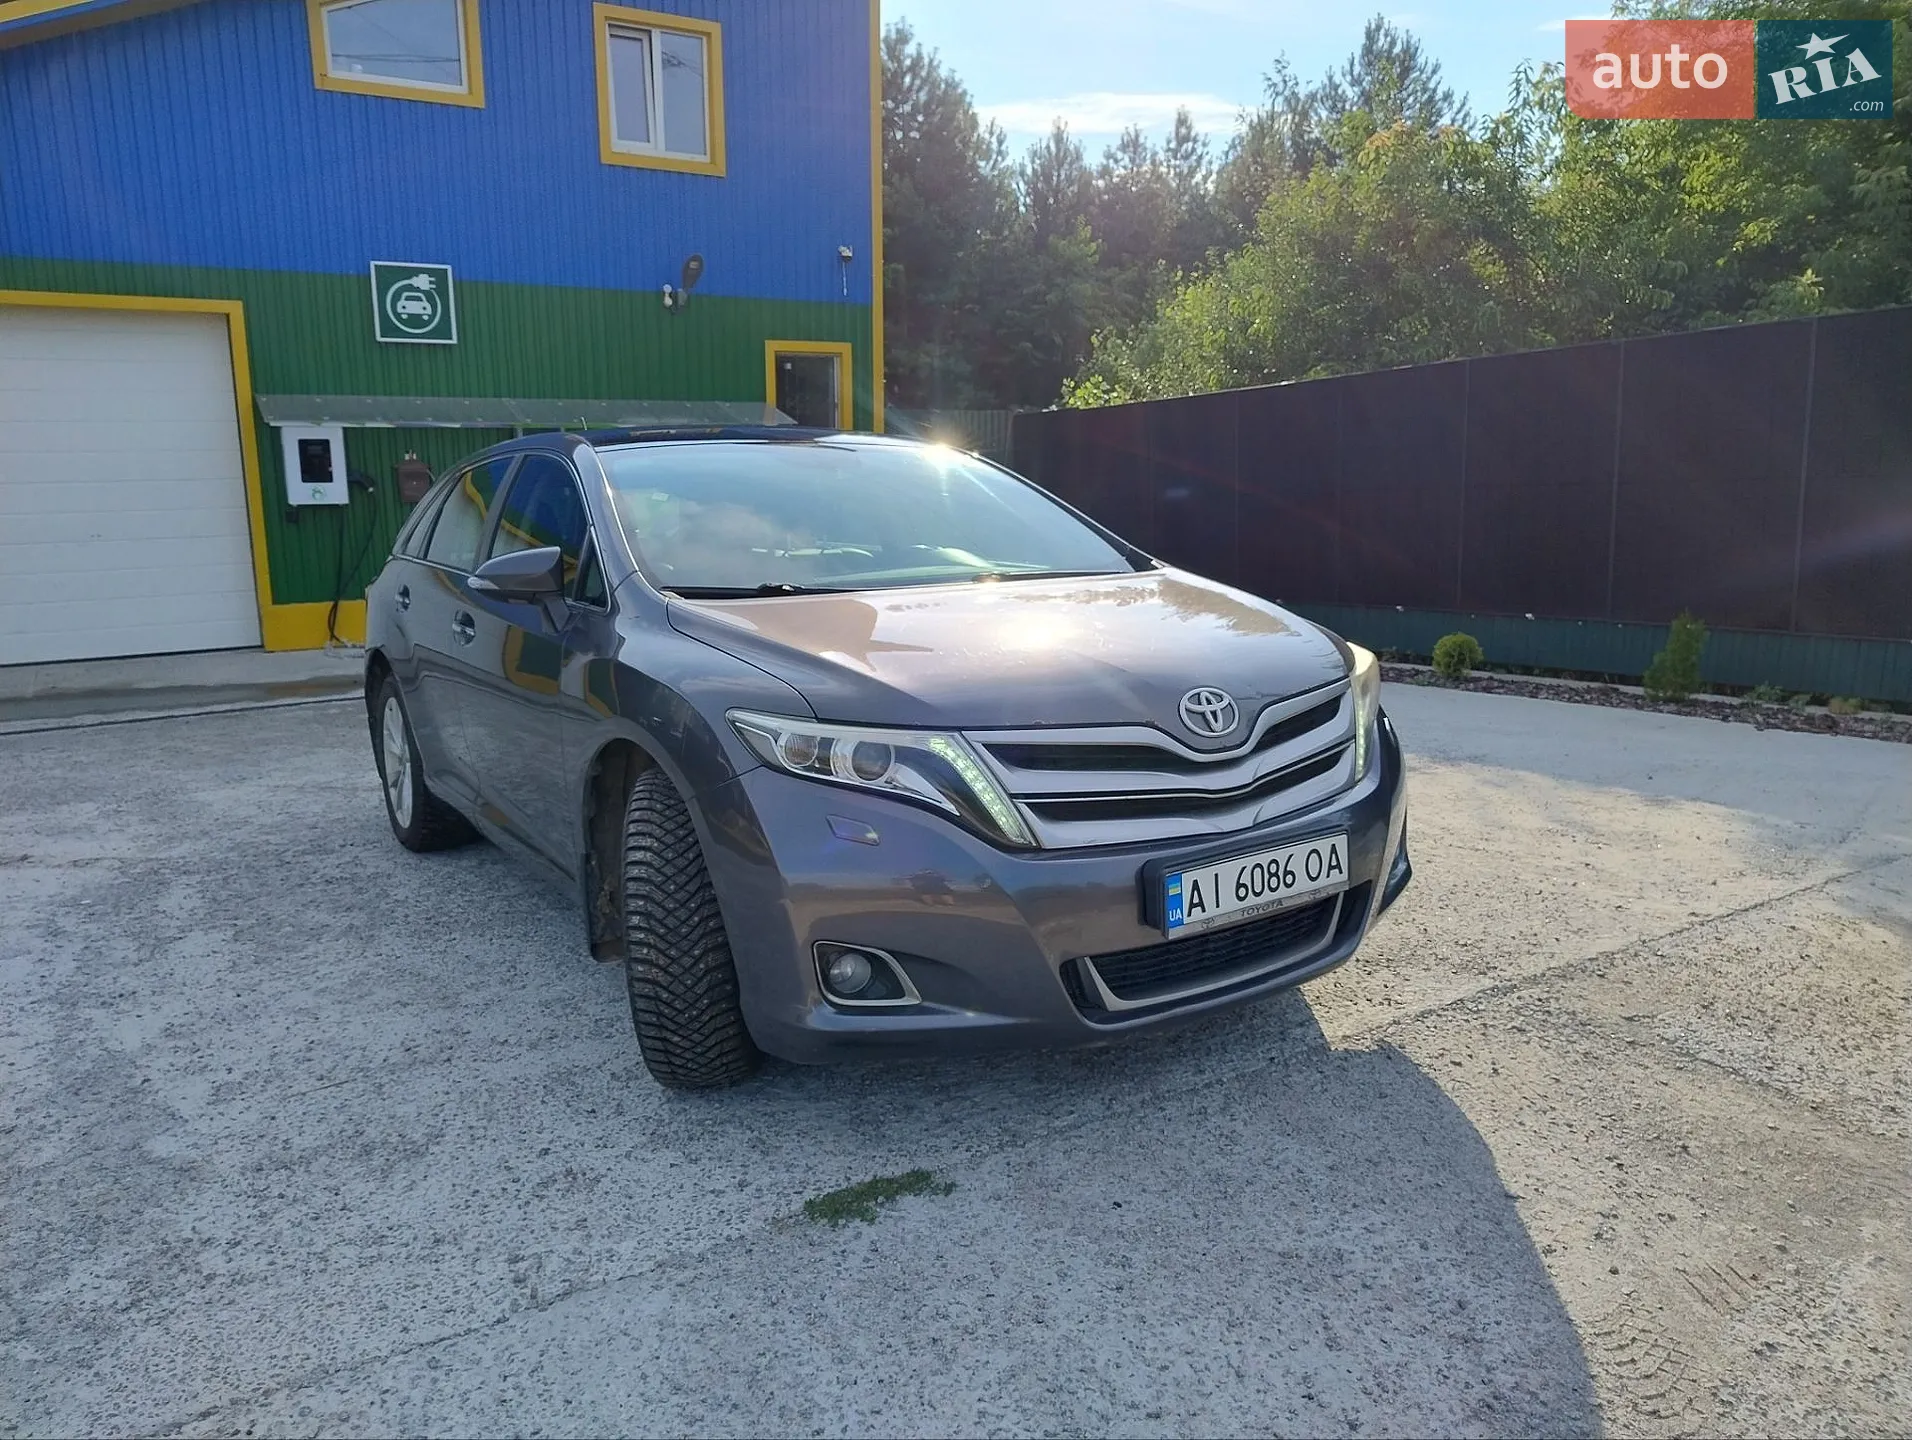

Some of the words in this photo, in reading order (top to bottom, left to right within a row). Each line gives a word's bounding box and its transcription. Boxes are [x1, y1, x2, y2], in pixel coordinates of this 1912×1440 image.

[1187, 872, 1220, 918] AI
[1235, 853, 1297, 902] 6086
[1304, 843, 1344, 883] OA
[1168, 908, 1183, 922] UA
[1240, 900, 1284, 917] TOYOTA
